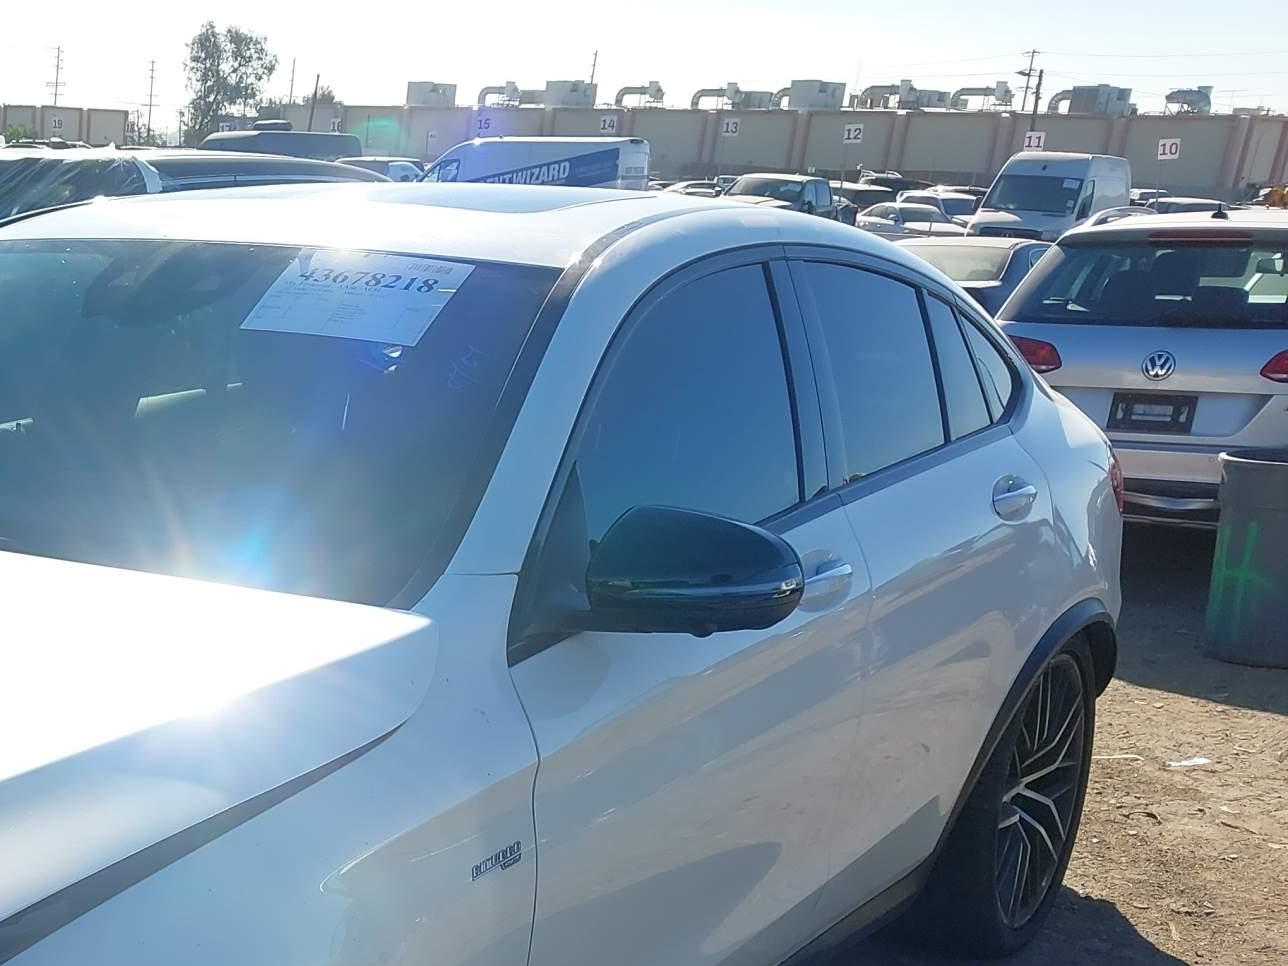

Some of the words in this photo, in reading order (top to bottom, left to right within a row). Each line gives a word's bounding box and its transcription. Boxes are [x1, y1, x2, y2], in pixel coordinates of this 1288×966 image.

[477, 118, 490, 130] 15
[600, 118, 615, 130] 14
[724, 121, 738, 134] 13
[844, 127, 862, 141] 12
[1024, 135, 1043, 149] 11
[1159, 142, 1179, 156] 10
[513, 161, 570, 184] WIZARD
[299, 268, 439, 293] 43678218
